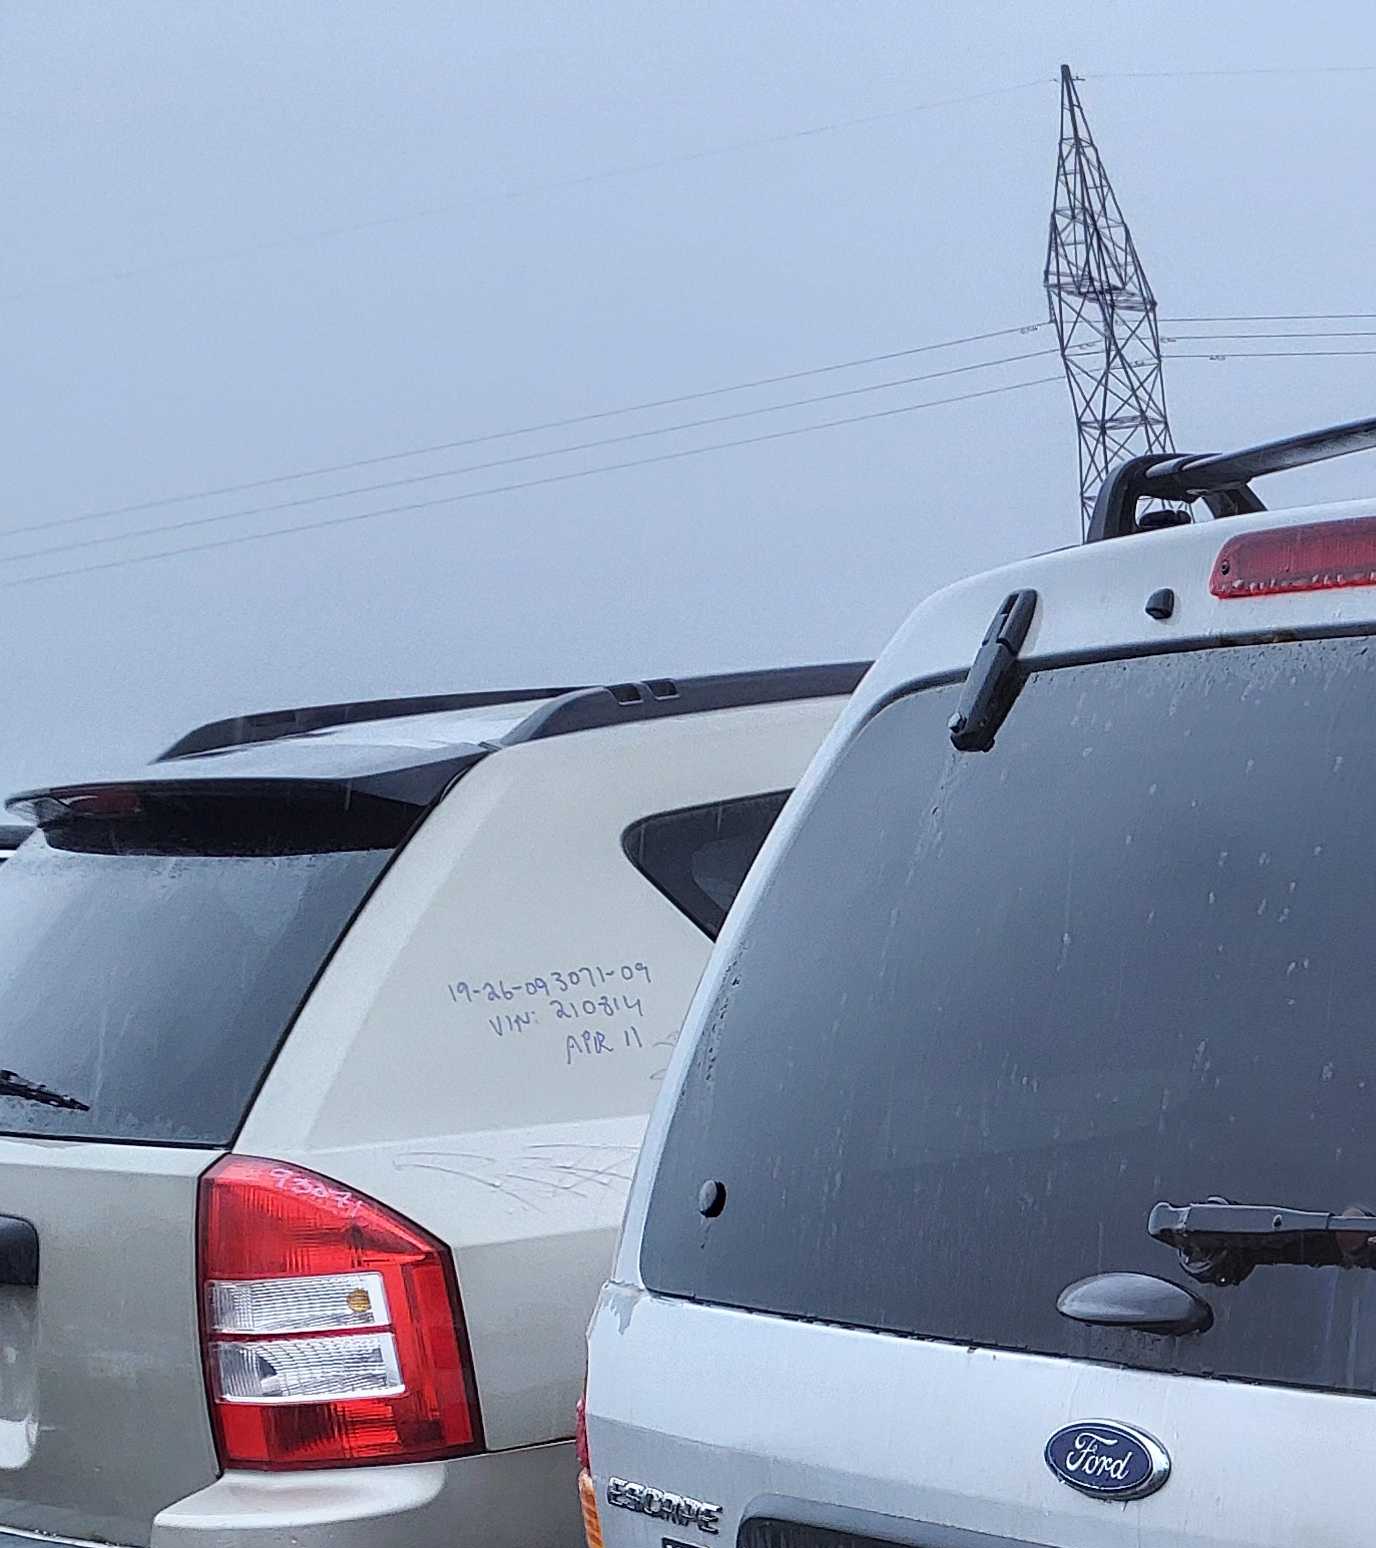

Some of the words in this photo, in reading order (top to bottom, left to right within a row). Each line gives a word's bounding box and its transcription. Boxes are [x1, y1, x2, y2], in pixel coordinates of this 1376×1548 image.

[488, 1010, 539, 1037] VIN:
[565, 1030, 615, 1065] APR
[1065, 1432, 1133, 1480] Ford
[606, 1476, 723, 1535] ESCAPE
